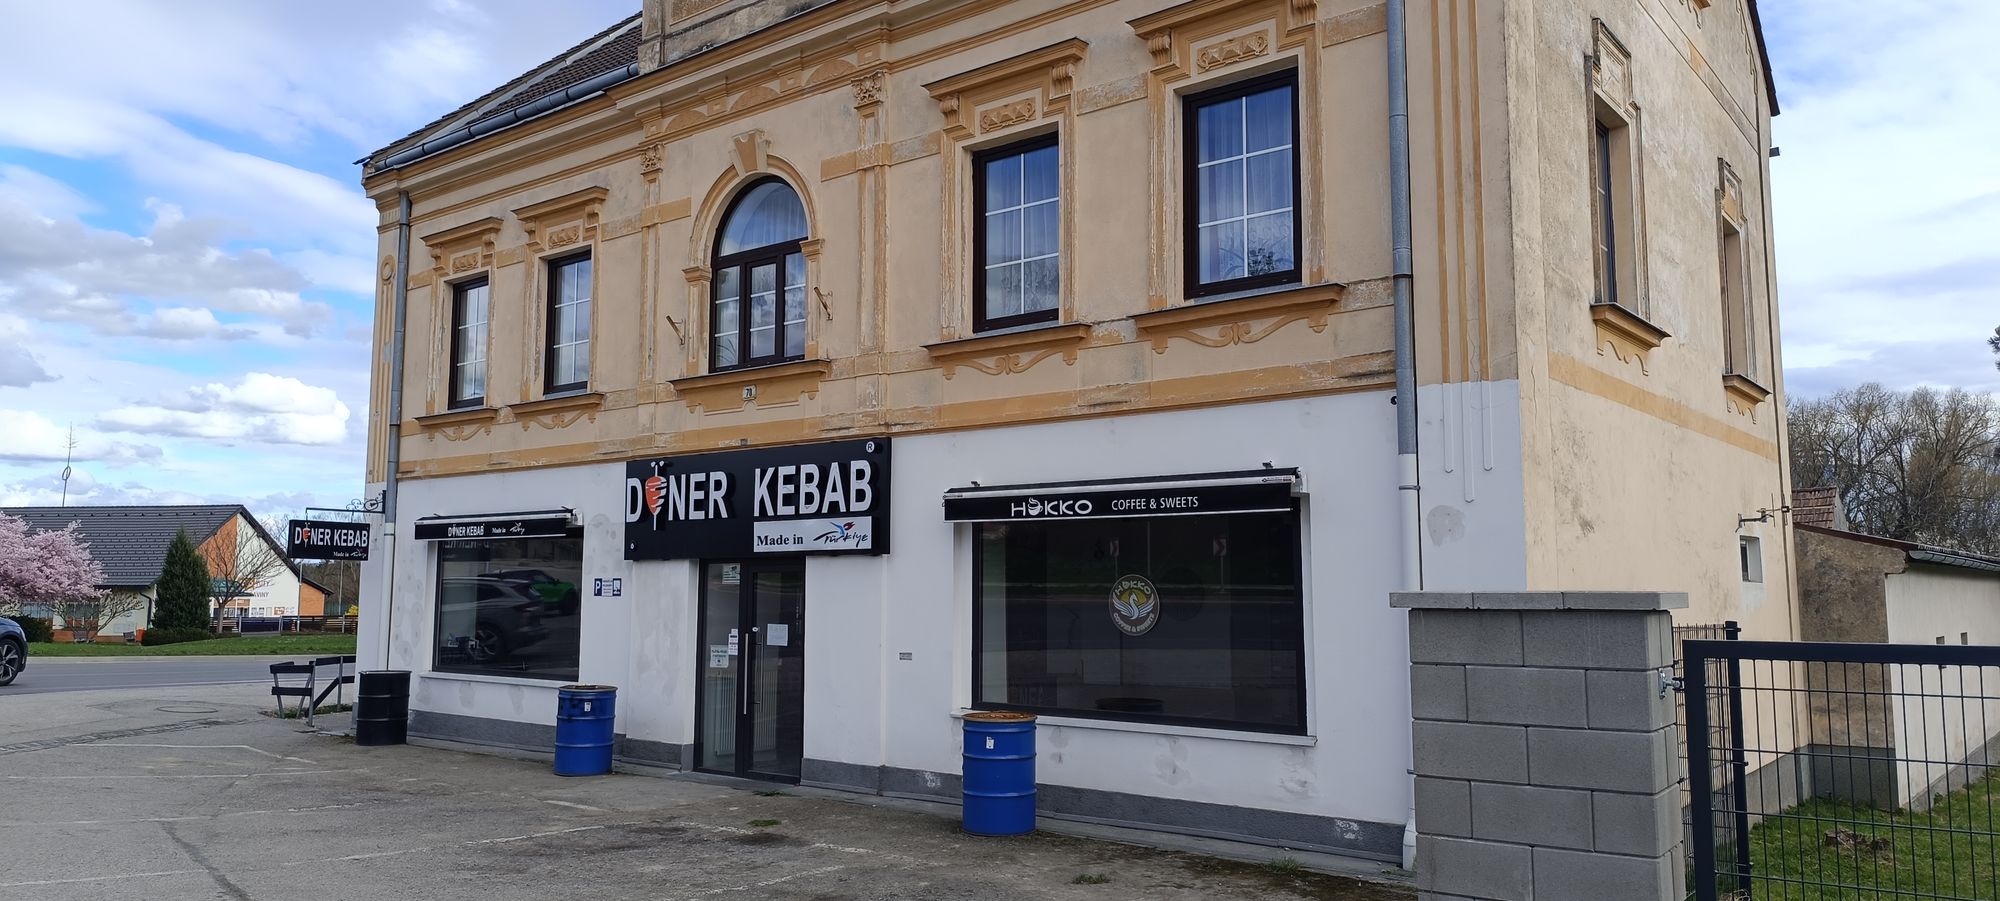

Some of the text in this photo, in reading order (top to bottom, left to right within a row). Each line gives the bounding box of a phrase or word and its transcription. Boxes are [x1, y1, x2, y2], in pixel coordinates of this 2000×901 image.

[753, 459, 873, 517] KEBAB
[1111, 498, 1146, 511] COFFEE
[1149, 498, 1157, 509] &
[1160, 496, 1199, 509] SWEETS
[466, 525, 484, 536] KEBAB
[333, 529, 368, 548] KEBAB
[757, 534, 789, 546] Made
[792, 533, 804, 545] in
[595, 580, 601, 594] P
